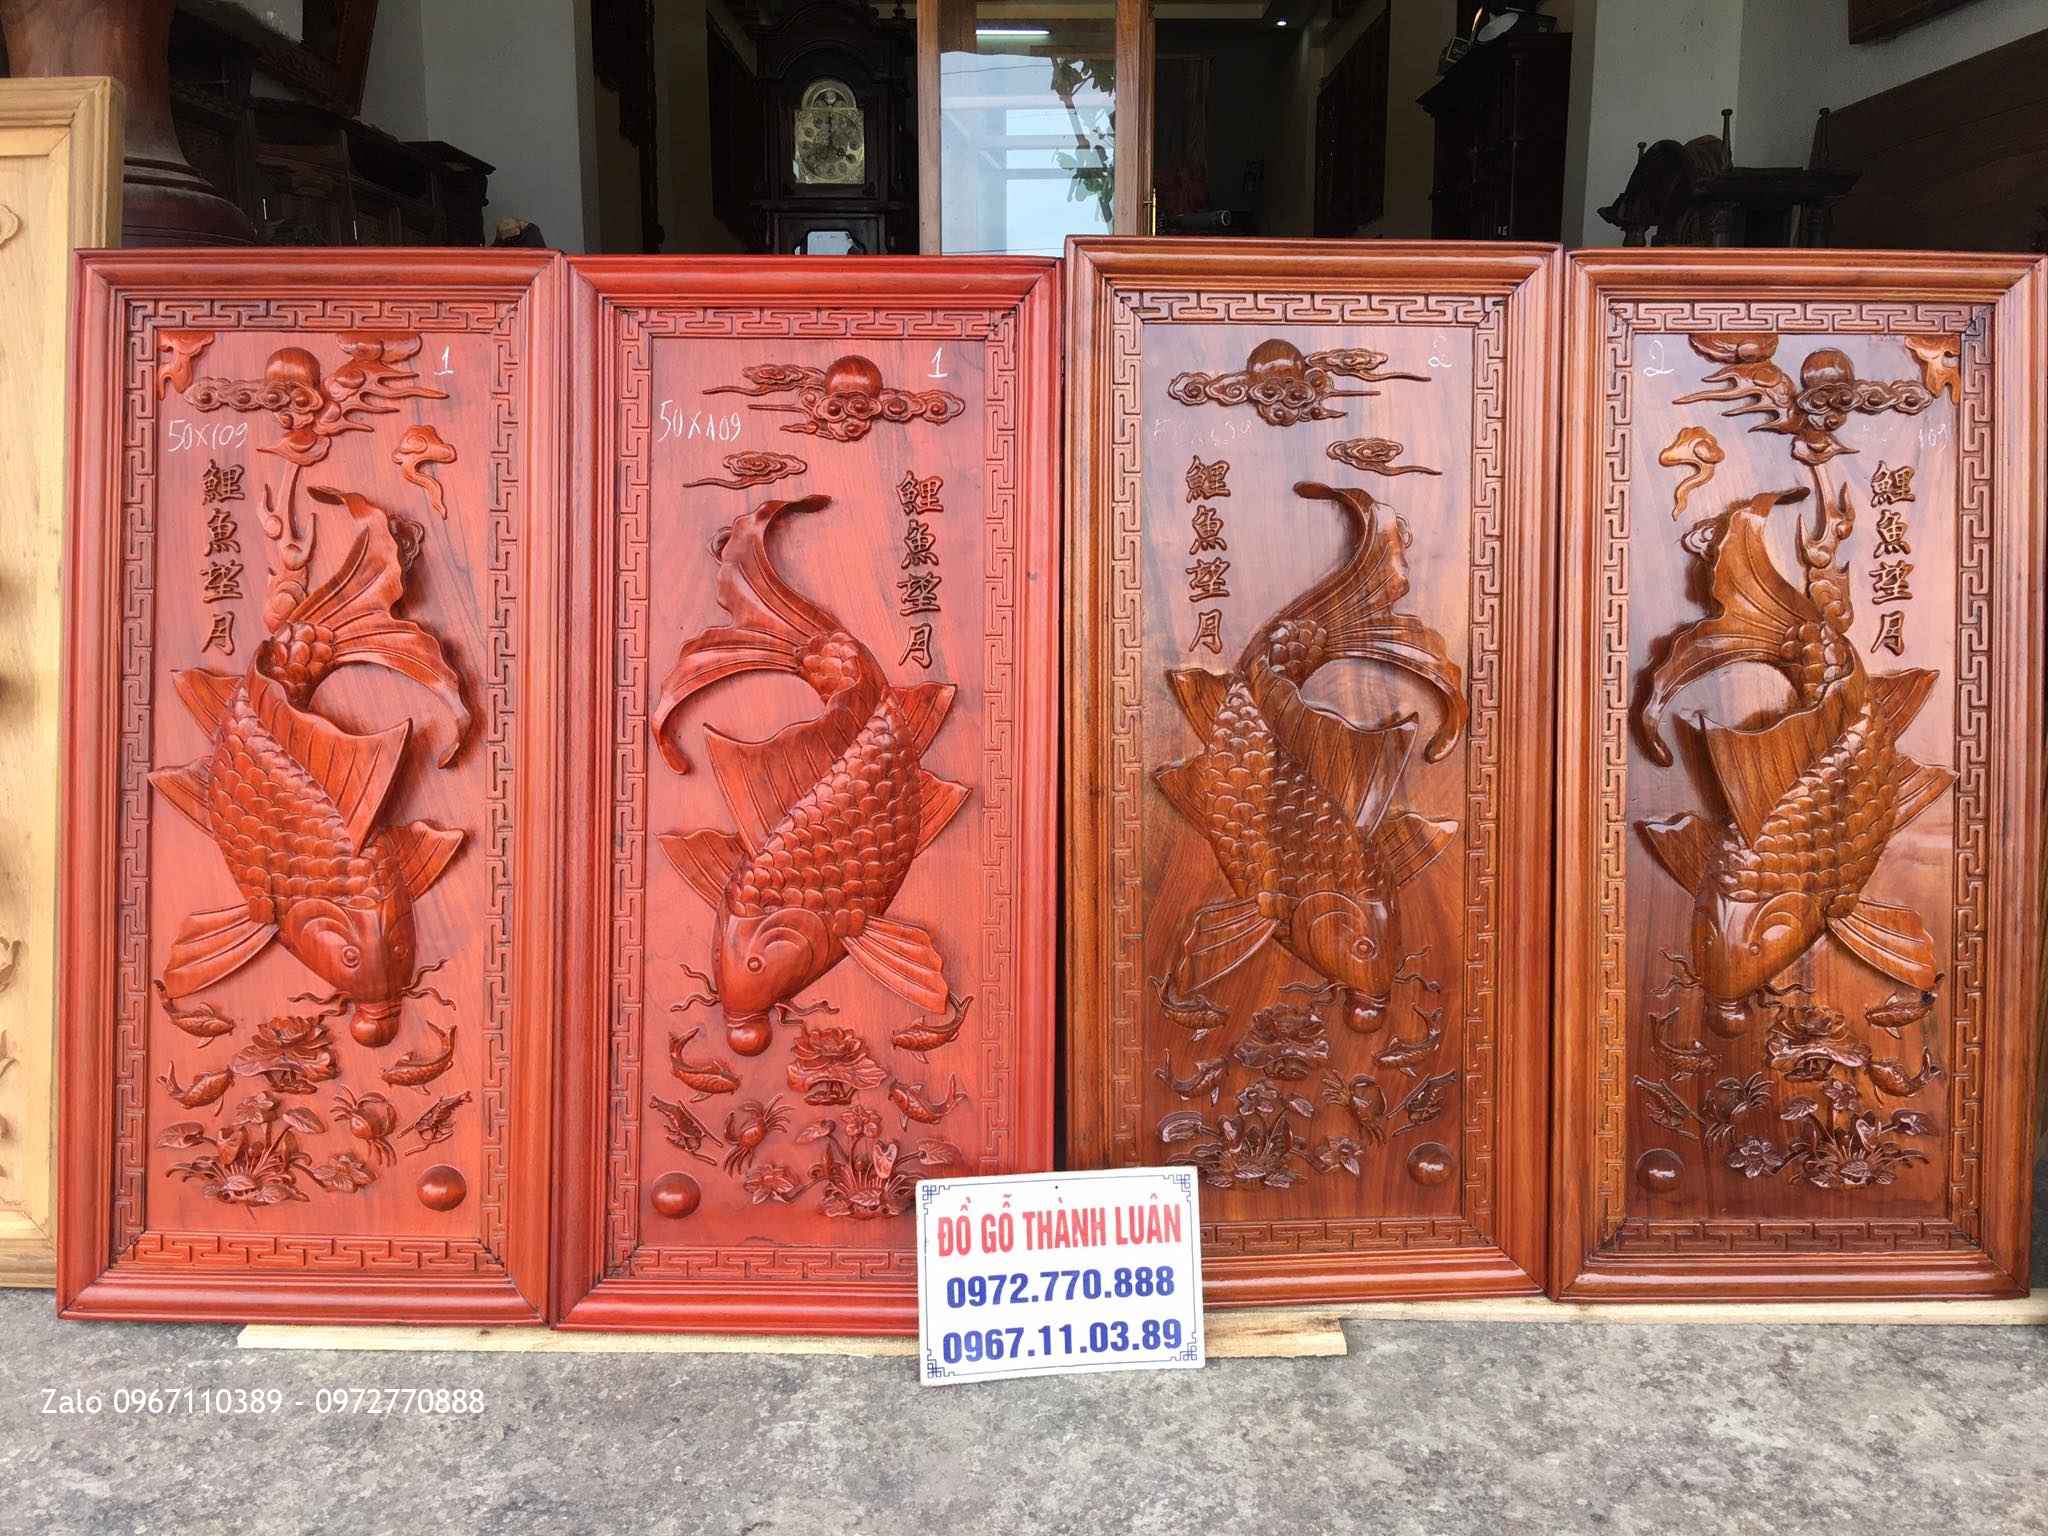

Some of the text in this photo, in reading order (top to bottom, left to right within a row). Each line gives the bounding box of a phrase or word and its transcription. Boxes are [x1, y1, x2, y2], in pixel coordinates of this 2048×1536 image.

[927, 347, 948, 379] 1
[1643, 340, 1674, 377] 2
[937, 1193, 1182, 1257] ĐỒ GỖ THÀNH LUÂN
[946, 1265, 1175, 1309] 0972.770.888
[942, 1318, 1182, 1364] 0967.11.03.89
